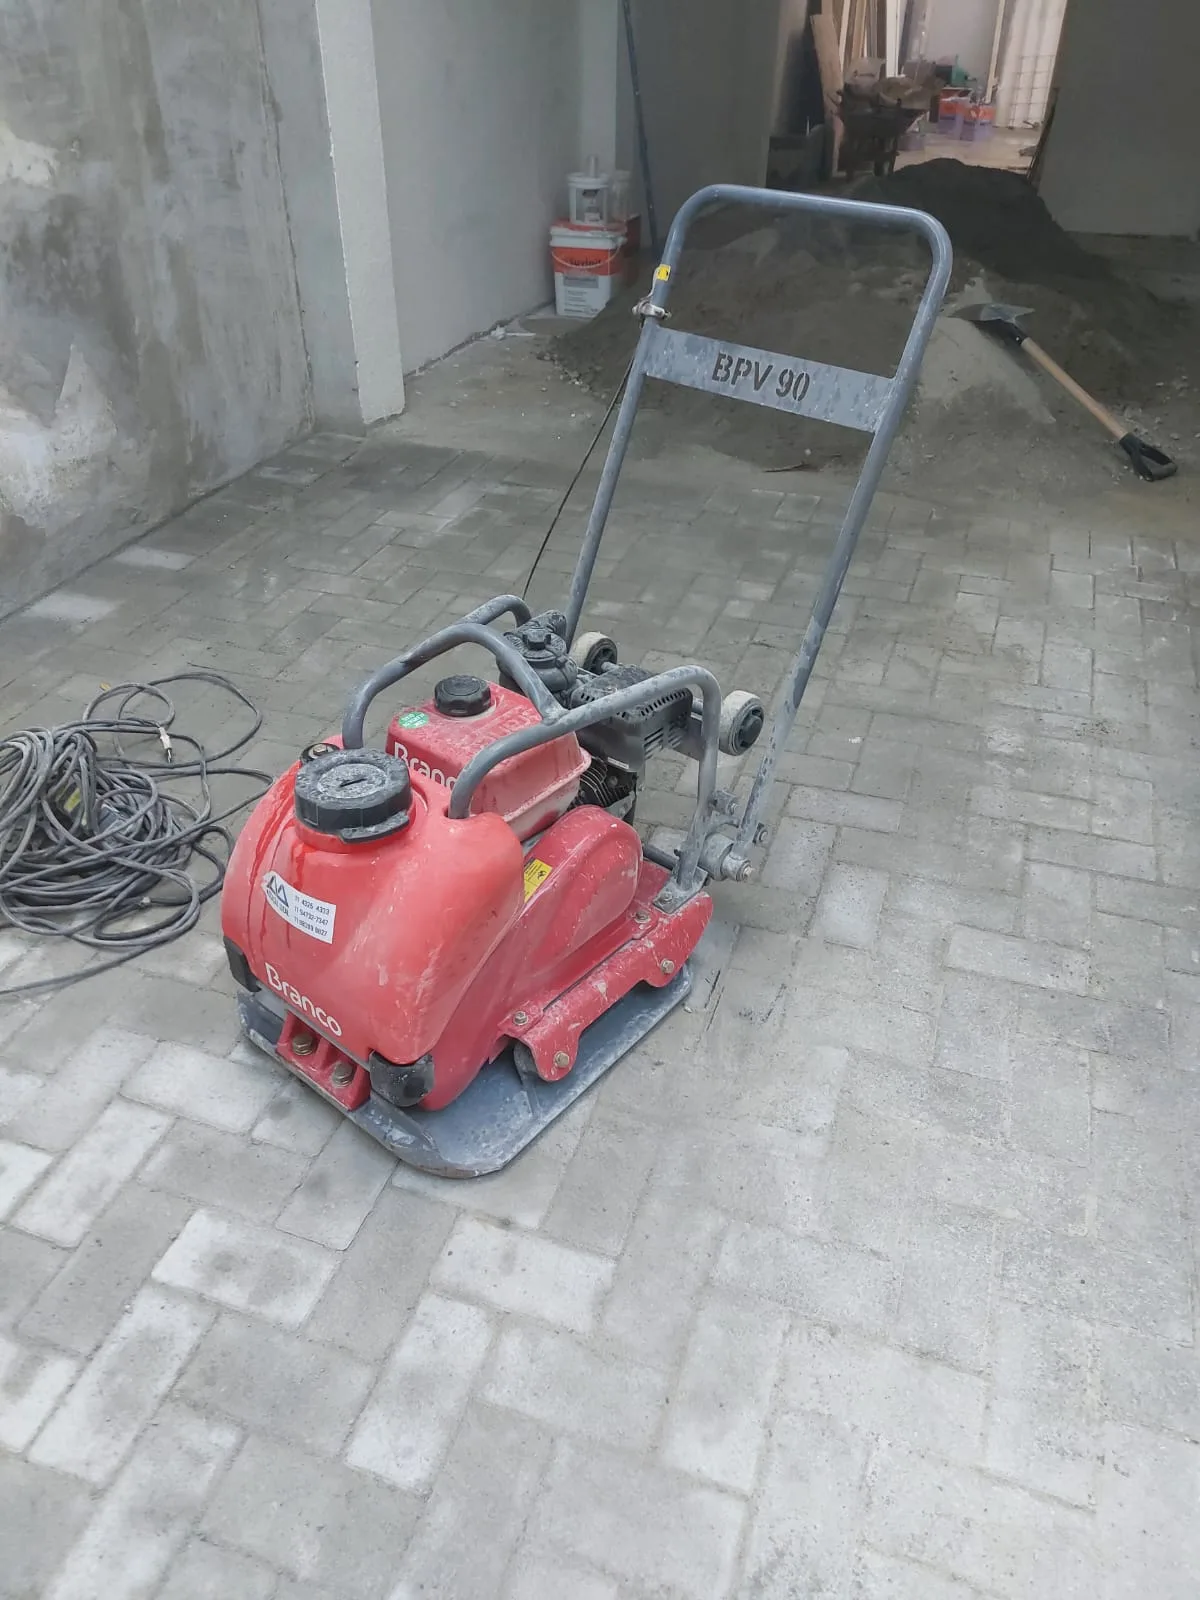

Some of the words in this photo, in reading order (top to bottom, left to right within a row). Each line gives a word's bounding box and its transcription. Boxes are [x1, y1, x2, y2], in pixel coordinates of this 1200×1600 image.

[712, 352, 773, 391] BPV
[776, 368, 810, 401] 90
[394, 741, 459, 791] Branc
[265, 962, 342, 1036] Branco
